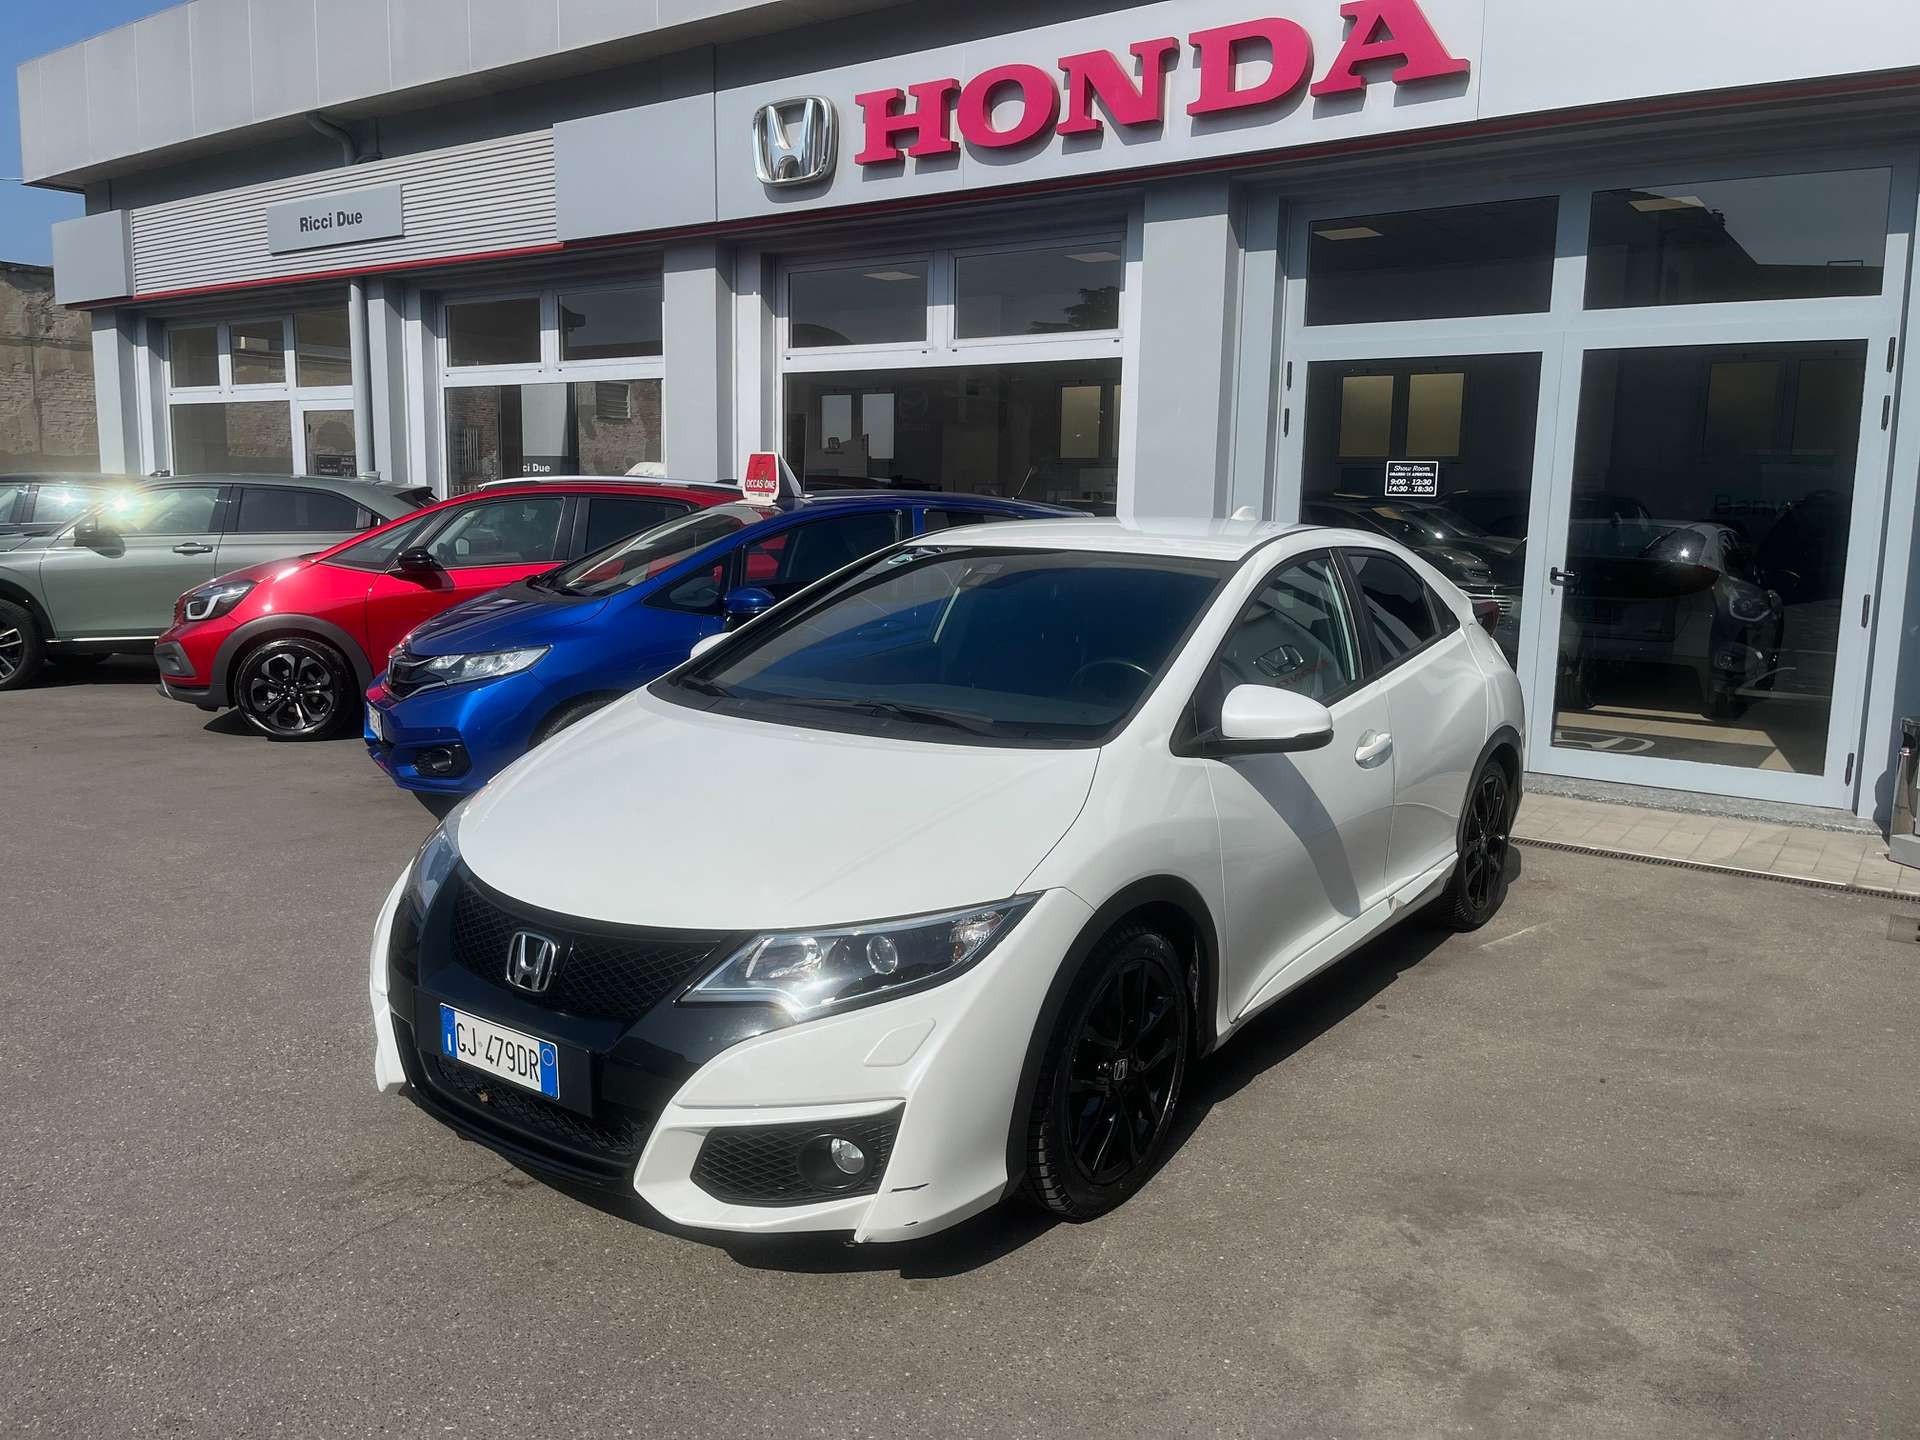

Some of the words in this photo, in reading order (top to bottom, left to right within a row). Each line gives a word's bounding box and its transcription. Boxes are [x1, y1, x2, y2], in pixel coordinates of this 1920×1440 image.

[854, 0, 1471, 166] HONDA
[299, 212, 333, 233] Ricci
[336, 210, 363, 228] Due
[532, 463, 551, 473] Due
[1390, 478, 1407, 486] 9:00
[1411, 478, 1432, 486] 12:30
[1412, 485, 1434, 493] 18:30
[456, 1022, 477, 1057] GJ
[485, 1034, 540, 1083] 479DR
